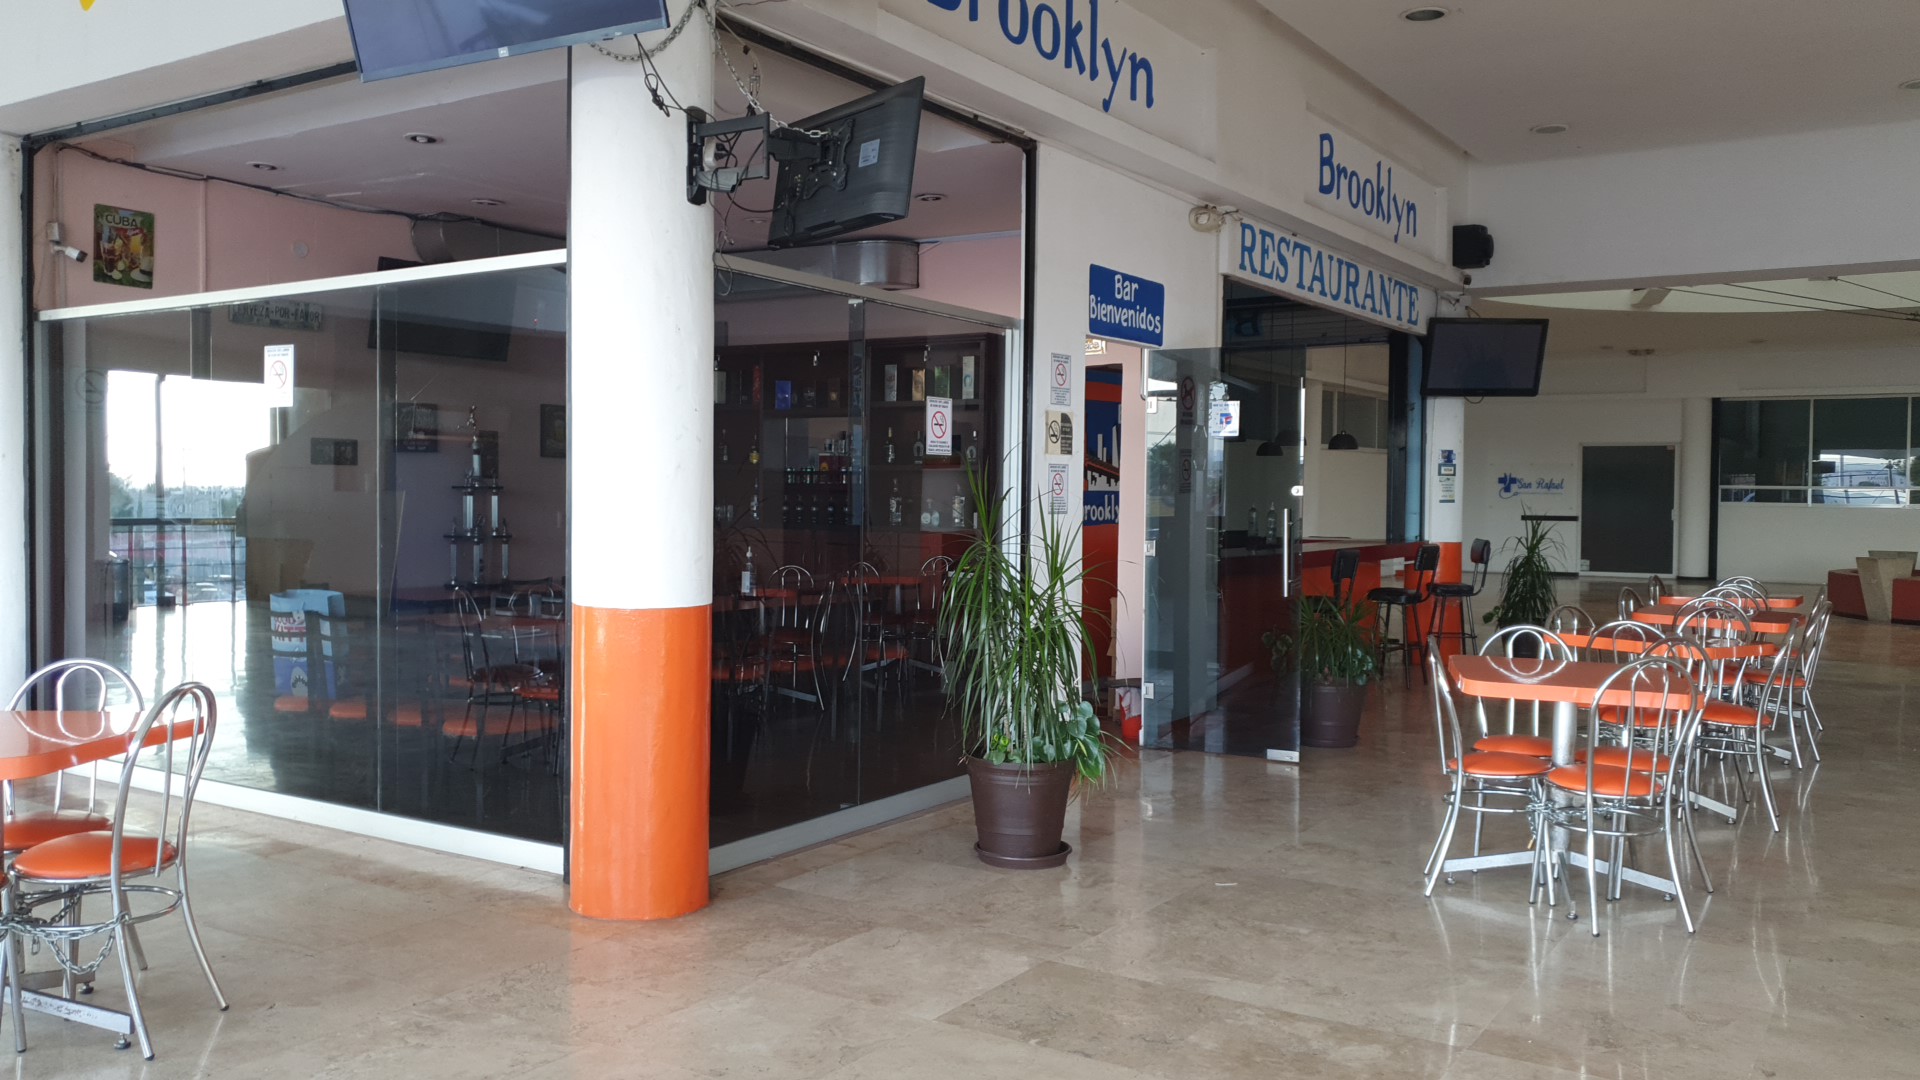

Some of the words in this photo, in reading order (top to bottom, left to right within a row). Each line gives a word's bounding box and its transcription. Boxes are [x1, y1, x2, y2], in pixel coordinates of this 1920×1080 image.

[926, 0, 1154, 113] ooklyn
[1319, 133, 1417, 244] Brooklyn
[105, 213, 138, 228] CUBA
[1114, 273, 1139, 303] Bar
[1239, 222, 1420, 326] RESTAURANTE
[1089, 294, 1162, 334] Bienvenidos
[1517, 478, 1532, 489] San
[1536, 478, 1565, 492] Rafael
[1084, 494, 1119, 524] rookly
